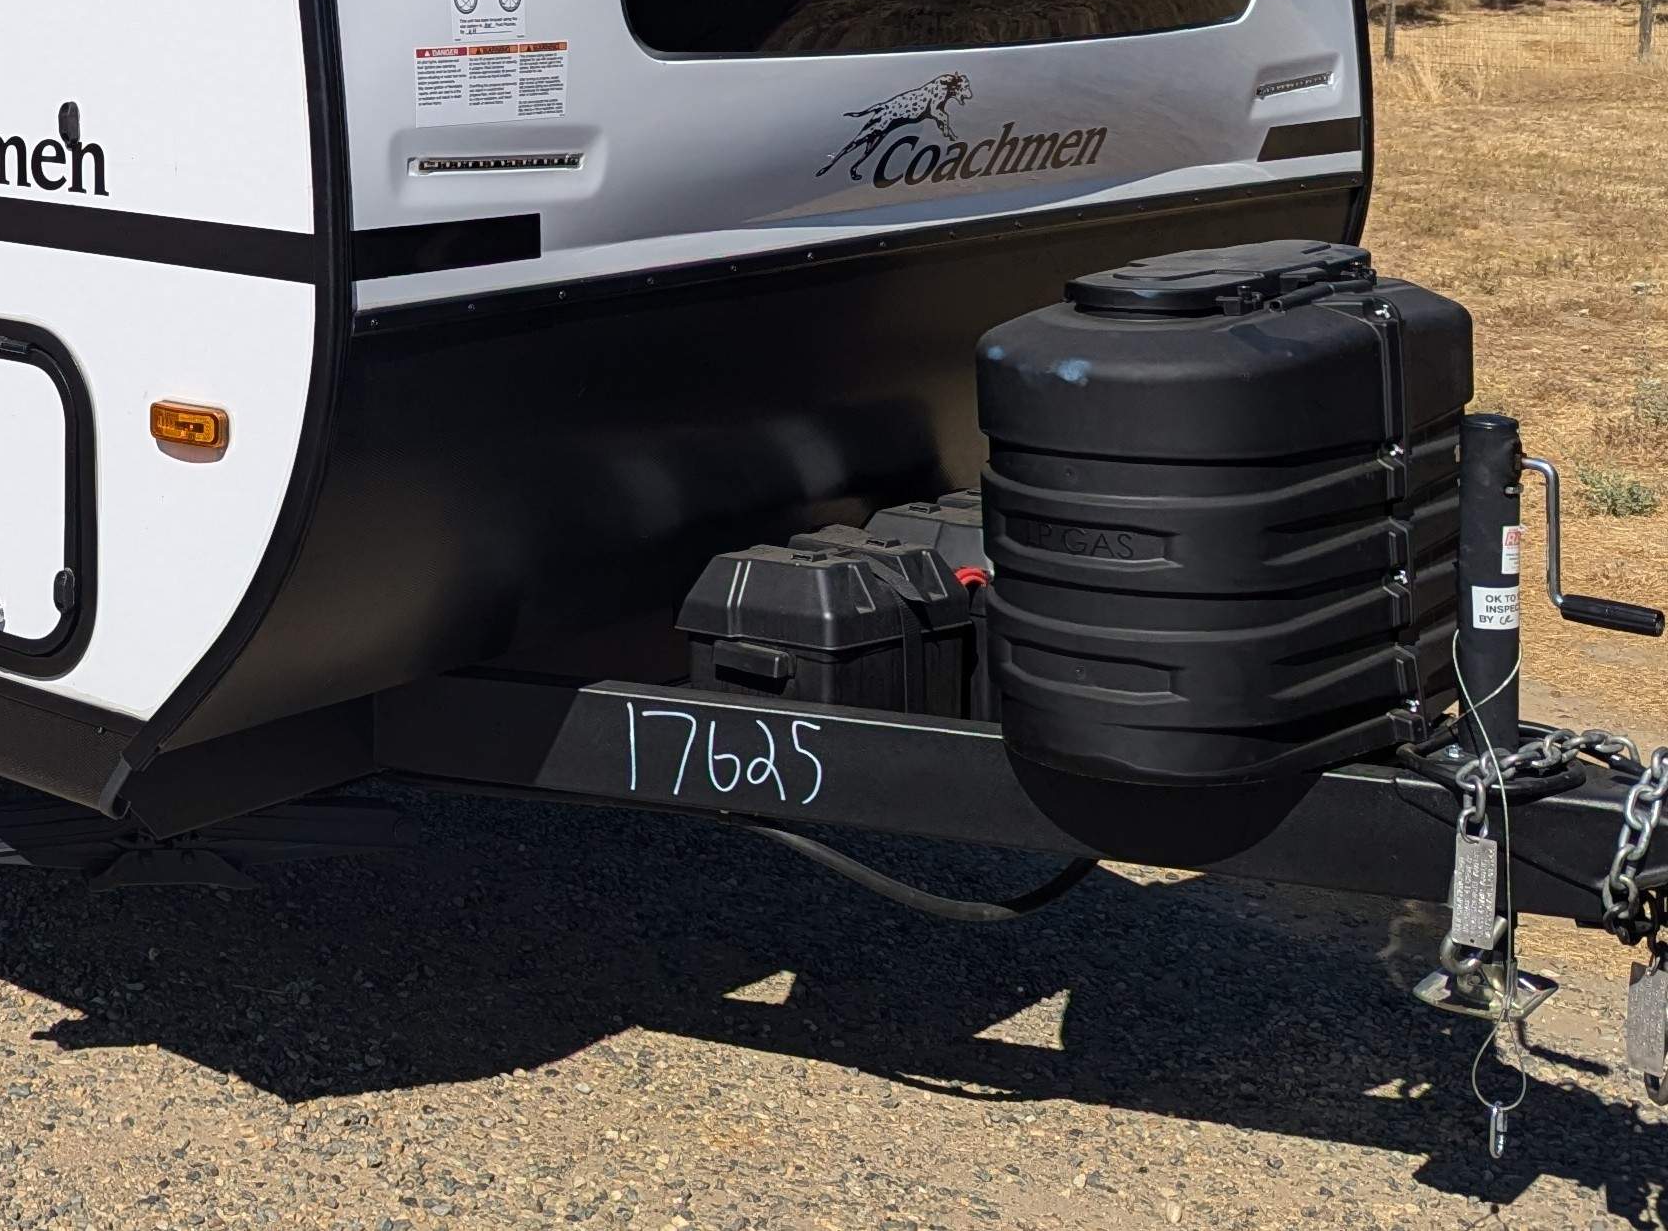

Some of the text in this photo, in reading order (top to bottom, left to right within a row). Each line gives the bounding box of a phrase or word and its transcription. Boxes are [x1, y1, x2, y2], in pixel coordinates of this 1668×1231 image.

[873, 122, 1108, 188] Coachmen
[1061, 528, 1135, 559] GAS
[1485, 594, 1517, 603] OK TO
[1479, 614, 1494, 624] BY
[627, 701, 823, 804] 17625
